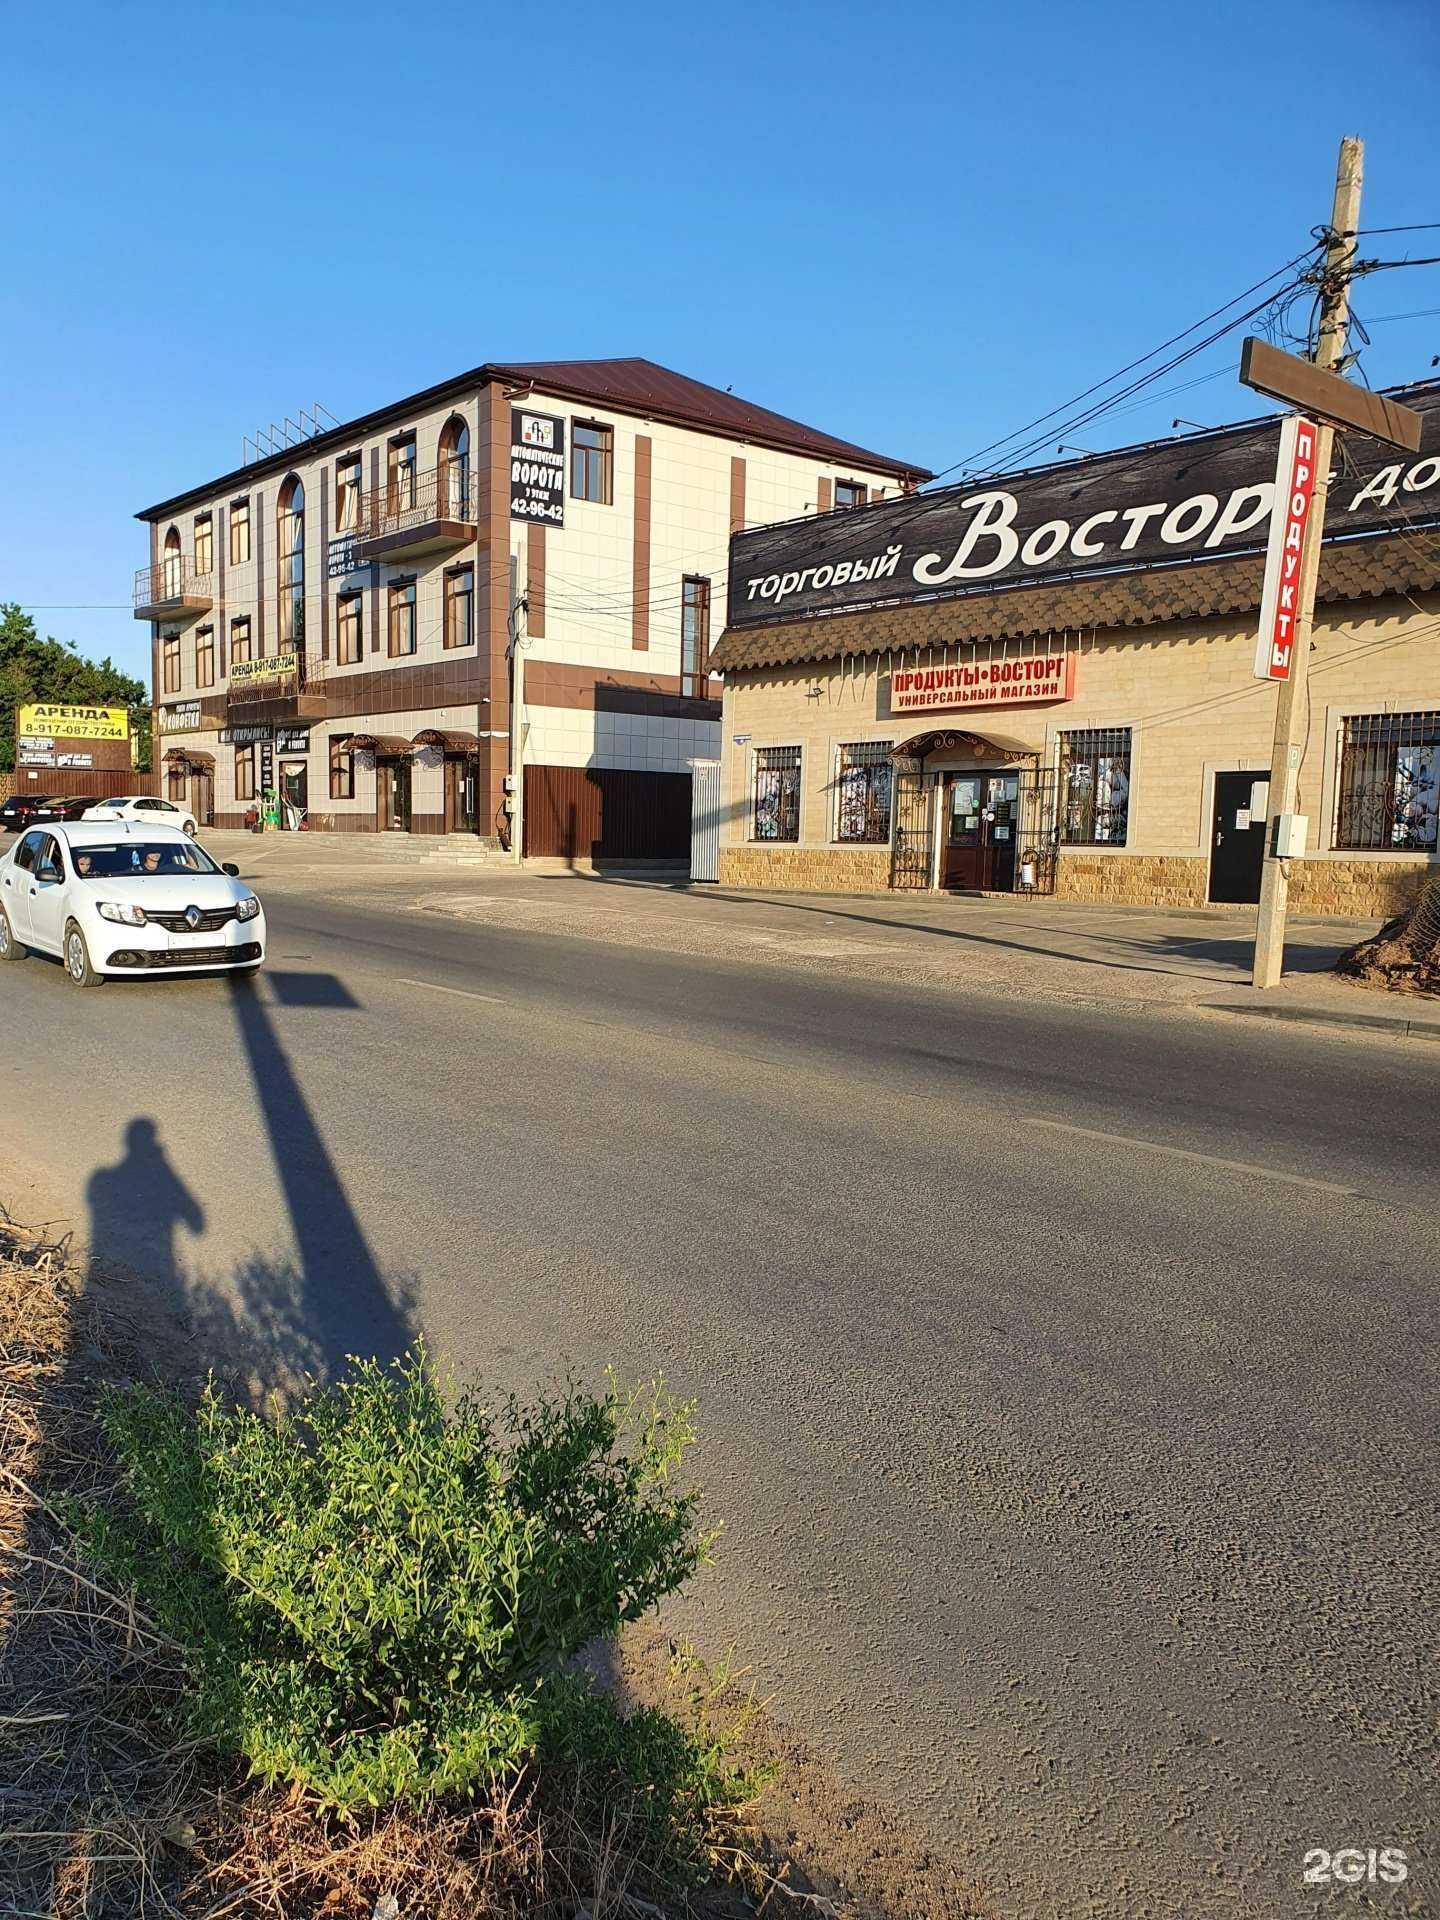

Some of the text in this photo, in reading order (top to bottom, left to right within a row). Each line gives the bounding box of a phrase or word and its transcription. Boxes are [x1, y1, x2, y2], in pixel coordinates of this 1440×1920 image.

[511, 461, 563, 491] ВОРОТА
[525, 487, 530, 497] 3
[511, 498, 563, 520] 42-96-42
[747, 544, 903, 603] торговый
[912, 472, 1337, 585] Востор
[1271, 434, 1311, 667] ПРОДУКТЫ
[232, 663, 253, 676] АРЕНДА
[254, 655, 295, 673] 8-917-087-7244
[898, 683, 1058, 707] УНИВЕРСАЛЬНЫЙ МАГАЗИН
[34, 707, 110, 720] АРЕНДА
[26, 723, 122, 737] 8-917-087-7244
